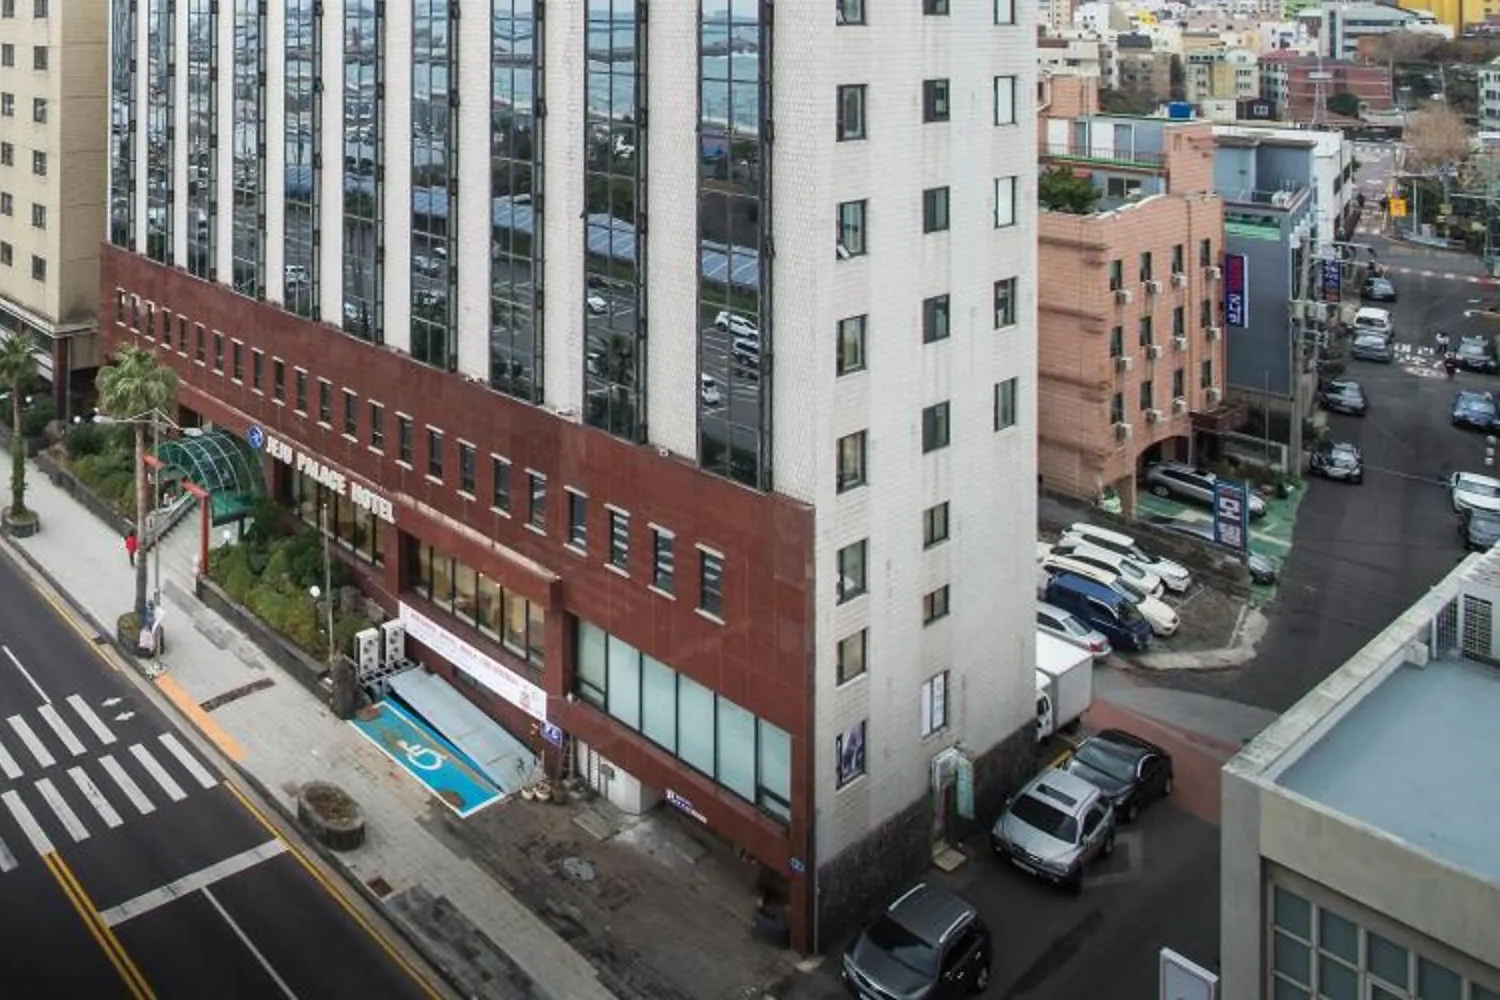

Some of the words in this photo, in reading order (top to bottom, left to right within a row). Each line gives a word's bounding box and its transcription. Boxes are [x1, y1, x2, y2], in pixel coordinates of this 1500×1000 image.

[266, 435, 293, 465] JEJU
[297, 451, 346, 496] PALACE
[351, 481, 396, 524] HOTEL
